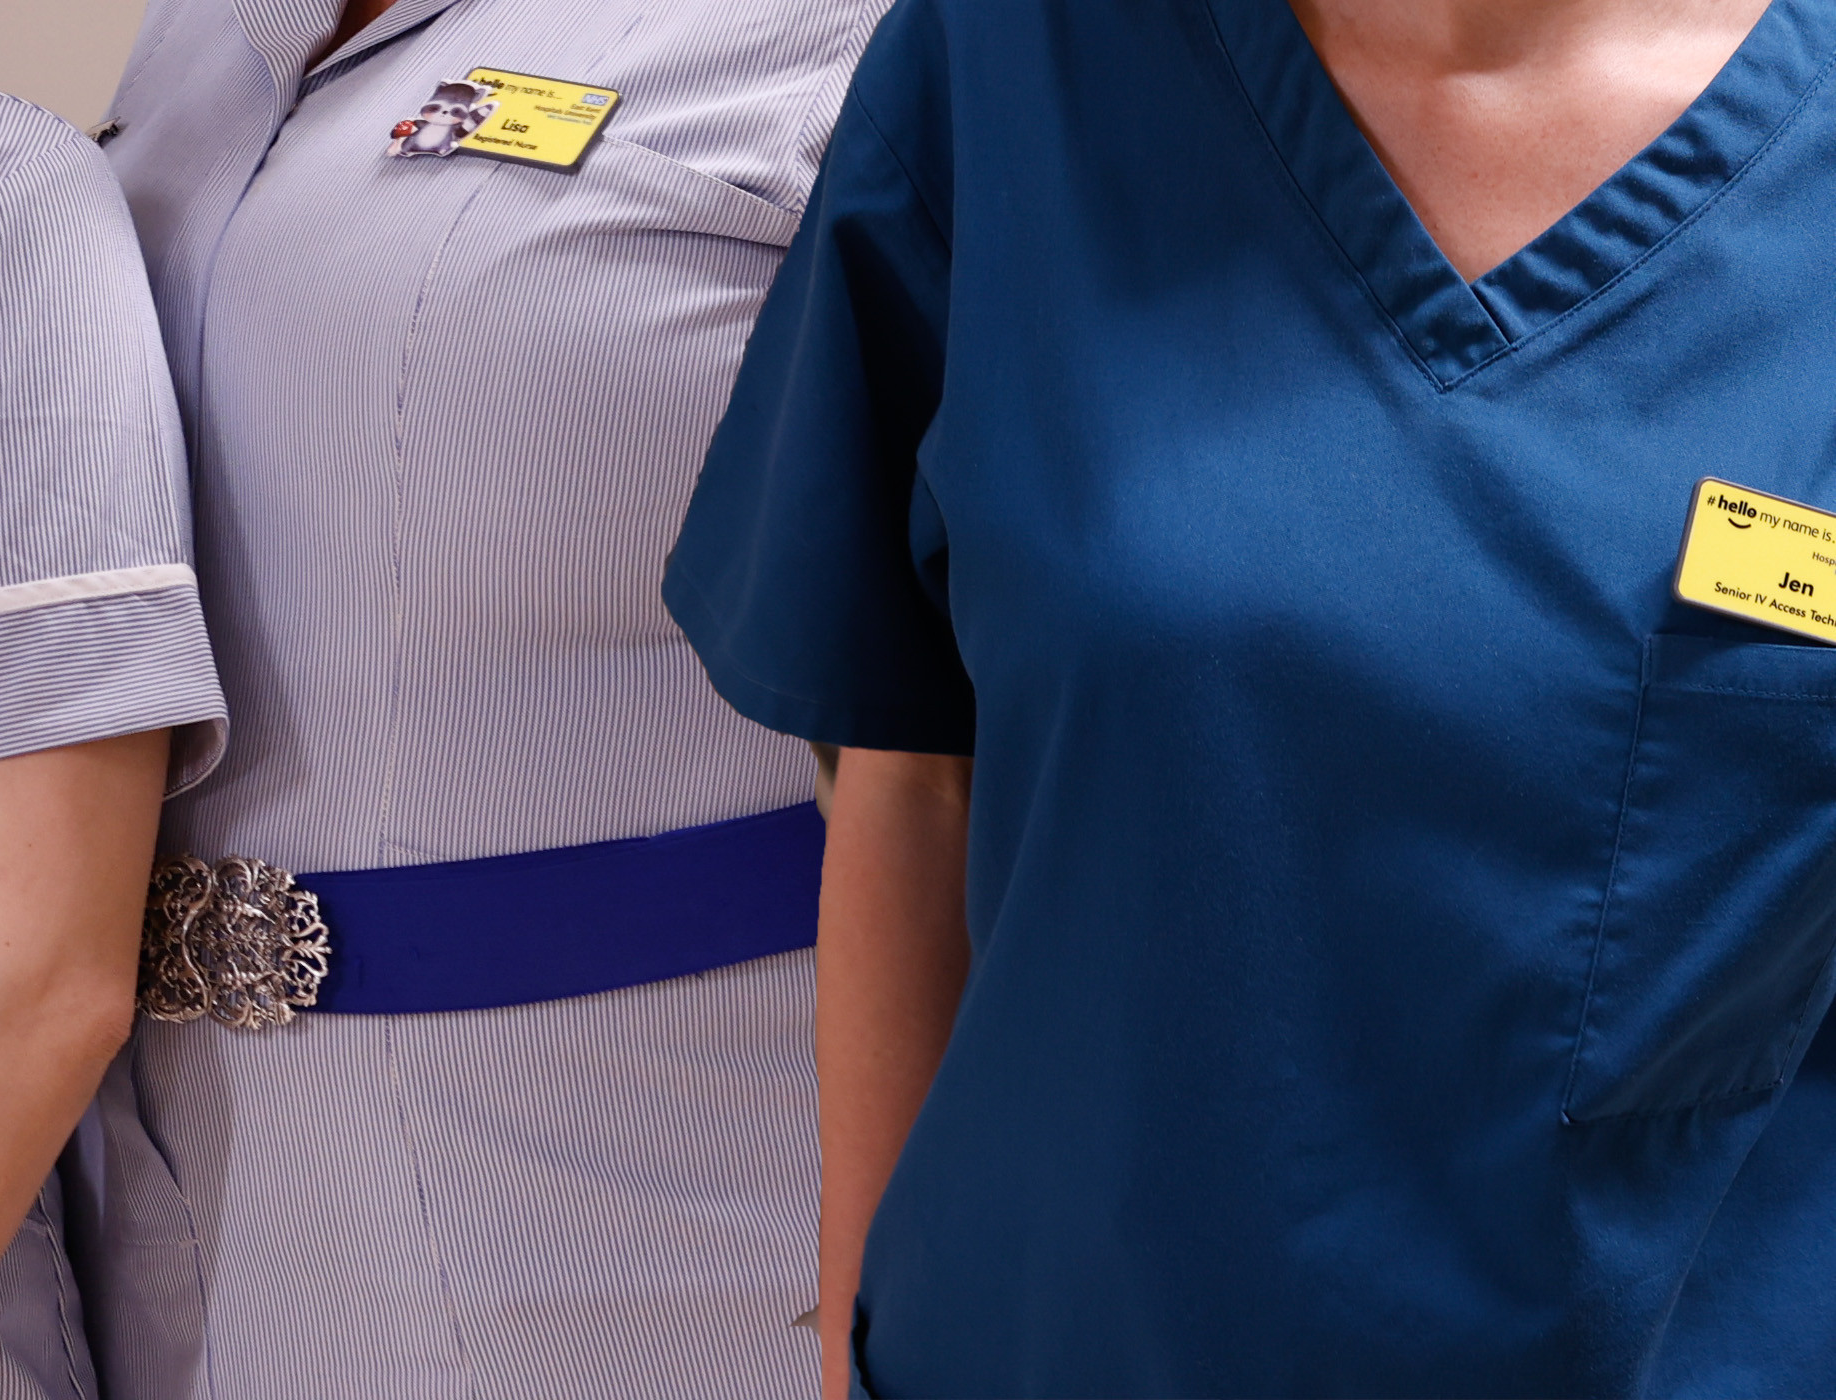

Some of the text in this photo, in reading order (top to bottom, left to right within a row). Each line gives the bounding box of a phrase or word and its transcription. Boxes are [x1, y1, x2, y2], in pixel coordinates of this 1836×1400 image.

[501, 118, 529, 134] Lisa
[1759, 511, 1781, 529] my
[1782, 518, 1820, 538] name
[1778, 571, 1815, 597] Jen
[1714, 581, 1752, 601] Senior
[1754, 593, 1768, 604] IV
[1768, 599, 1807, 618] Access
